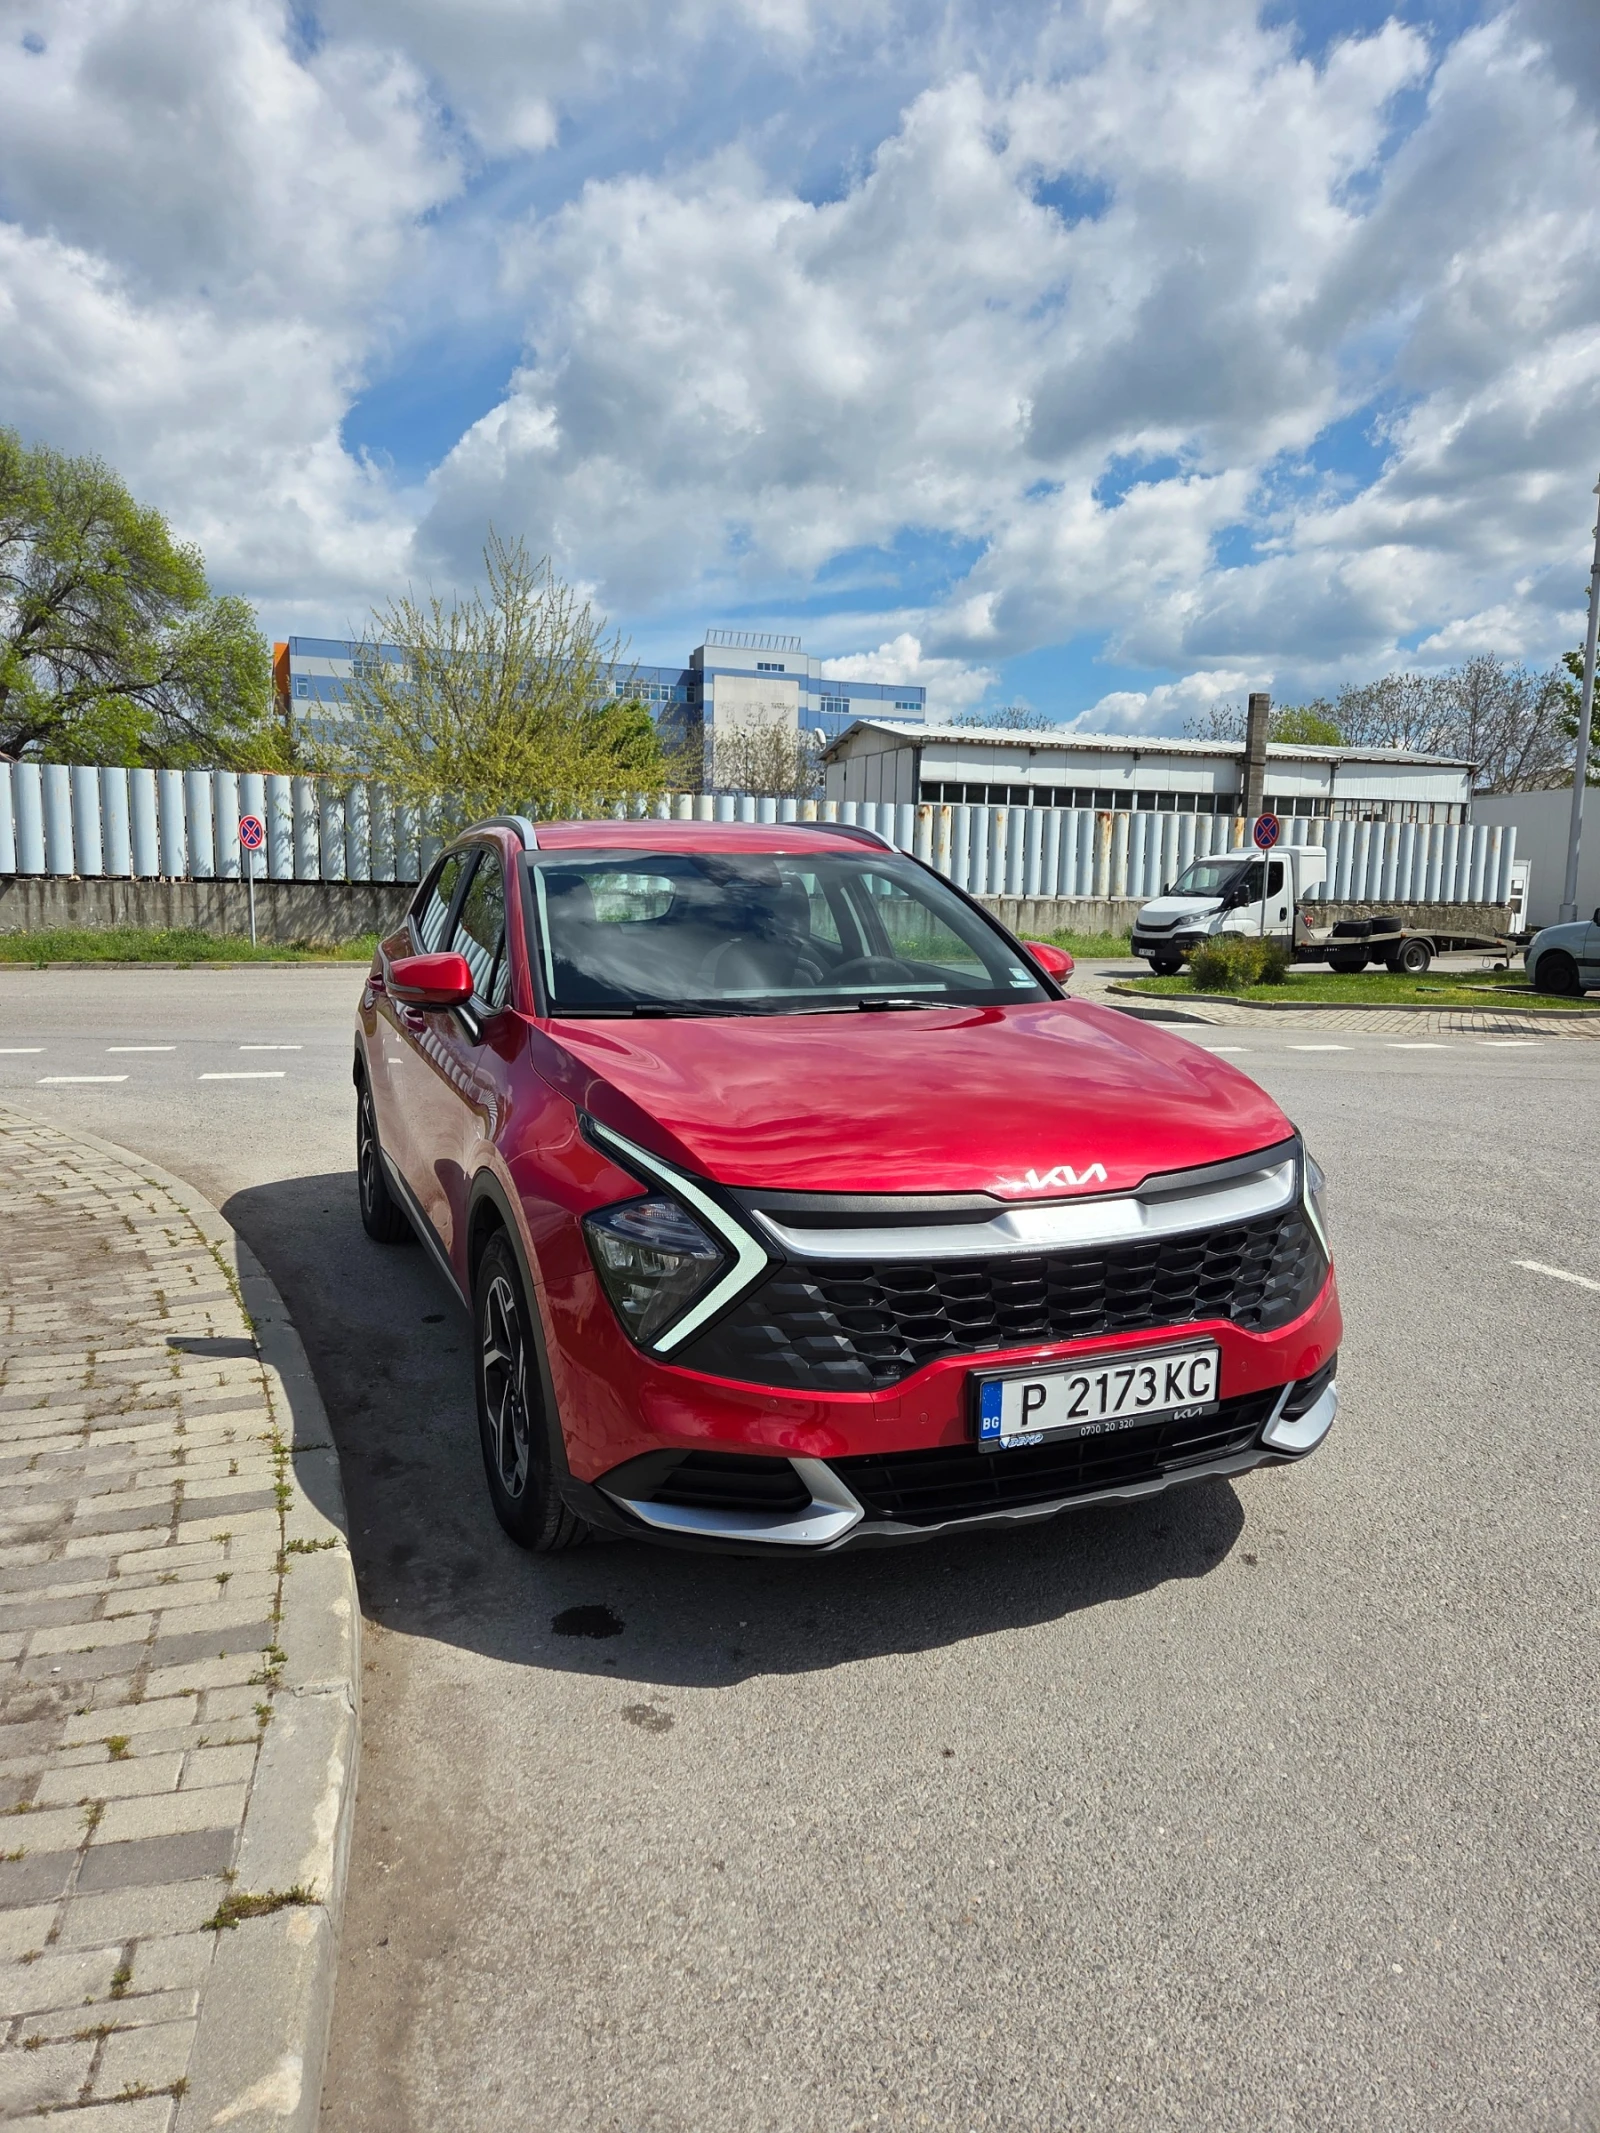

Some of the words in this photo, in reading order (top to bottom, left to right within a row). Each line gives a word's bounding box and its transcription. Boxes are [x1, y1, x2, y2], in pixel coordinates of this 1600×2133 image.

[1025, 1163, 1107, 1188] KIA
[1021, 1384, 1047, 1426] P
[1173, 1406, 1203, 1420] KIA
[983, 1416, 999, 1430] BG
[1080, 1423, 1101, 1436] 0700
[1105, 1421, 1116, 1432] 20
[1119, 1419, 1134, 1429] 320
